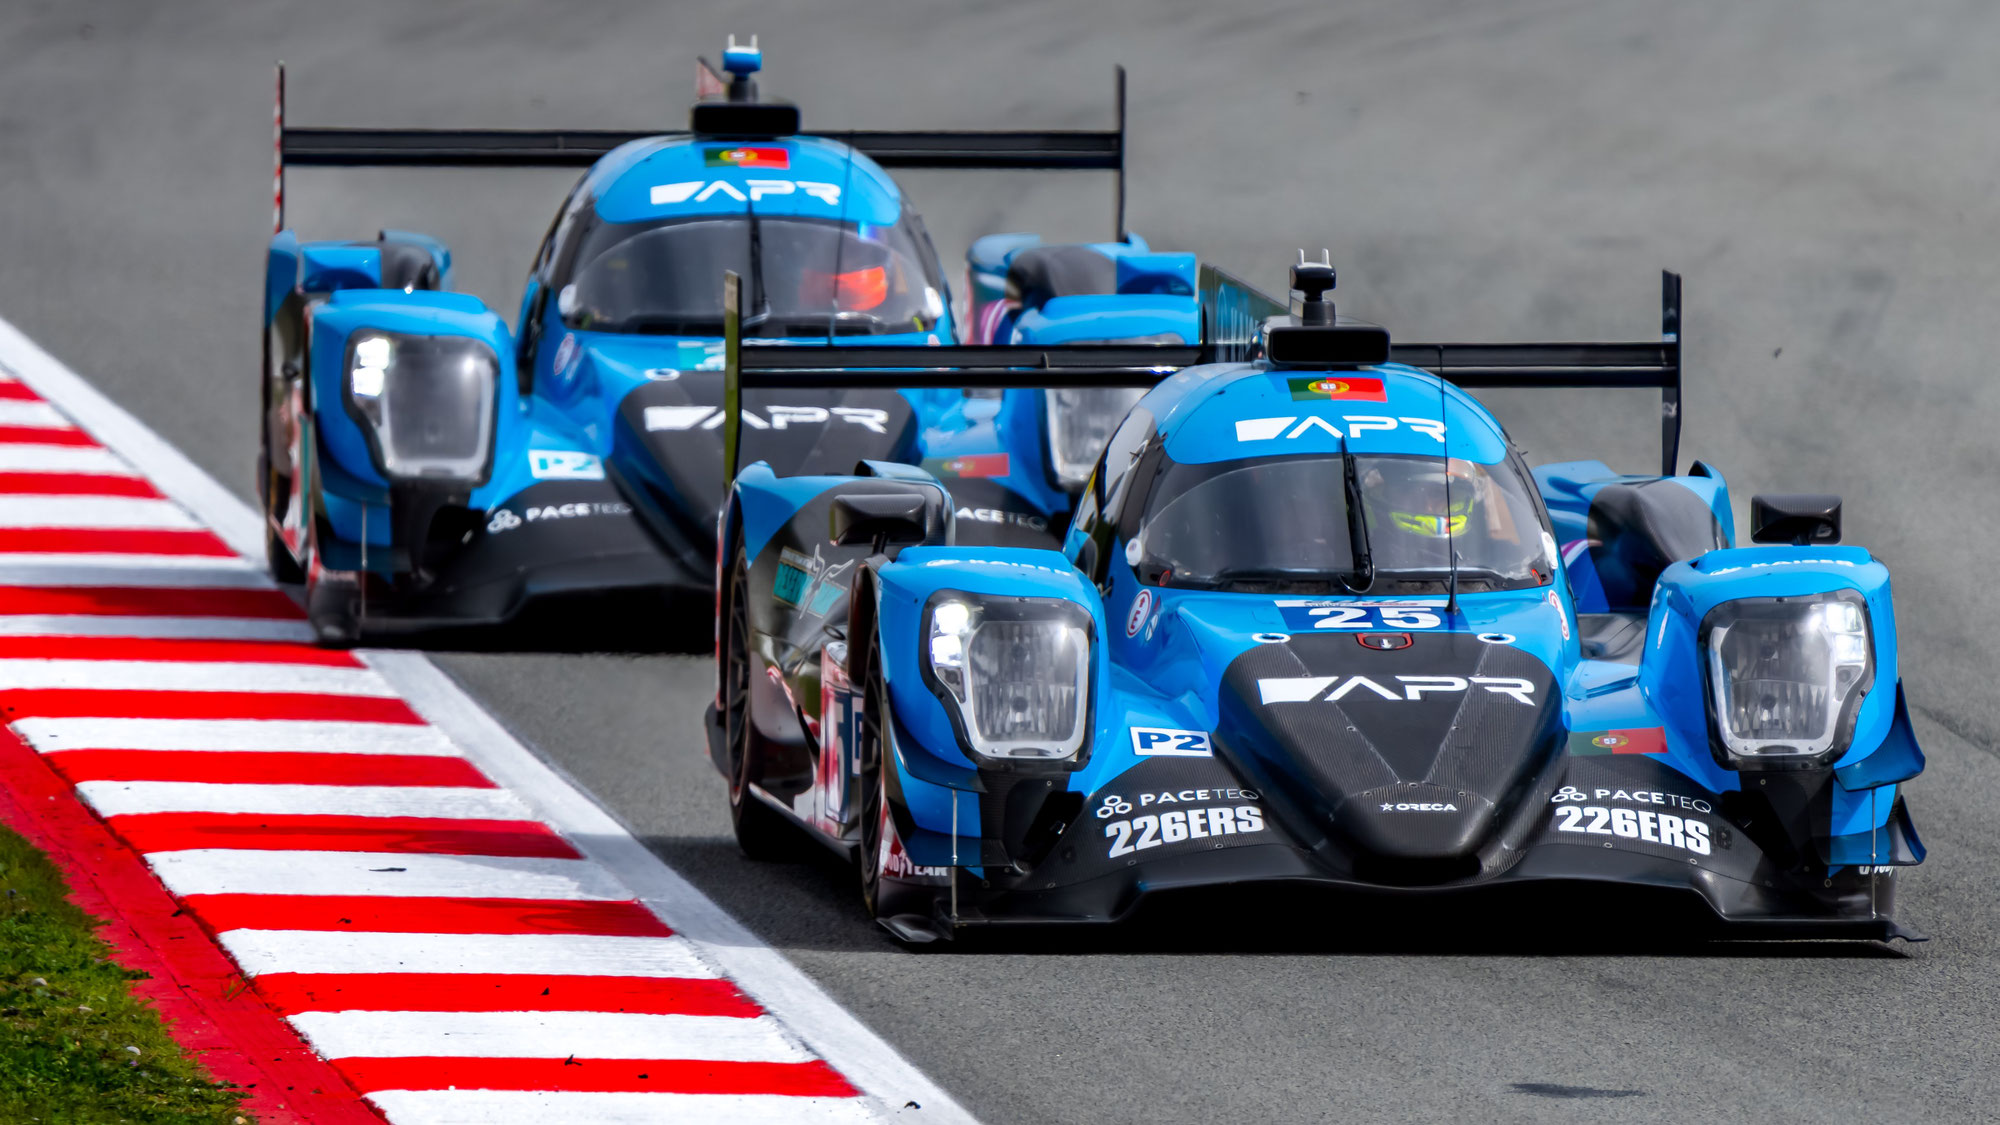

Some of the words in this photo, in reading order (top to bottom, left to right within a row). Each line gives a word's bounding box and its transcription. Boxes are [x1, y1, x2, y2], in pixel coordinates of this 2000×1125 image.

[694, 180, 841, 206] APR
[702, 406, 889, 434] APR
[1286, 415, 1446, 443] APR
[1308, 607, 1442, 629] 25
[1324, 675, 1536, 706] APR
[1138, 732, 1208, 752] P2
[1140, 788, 1259, 806] PACETEQ
[1396, 803, 1458, 812] ORECA
[1595, 789, 1712, 814] PACETEQ
[1105, 806, 1264, 858] 226ERS
[1555, 806, 1711, 856] 226ERS
